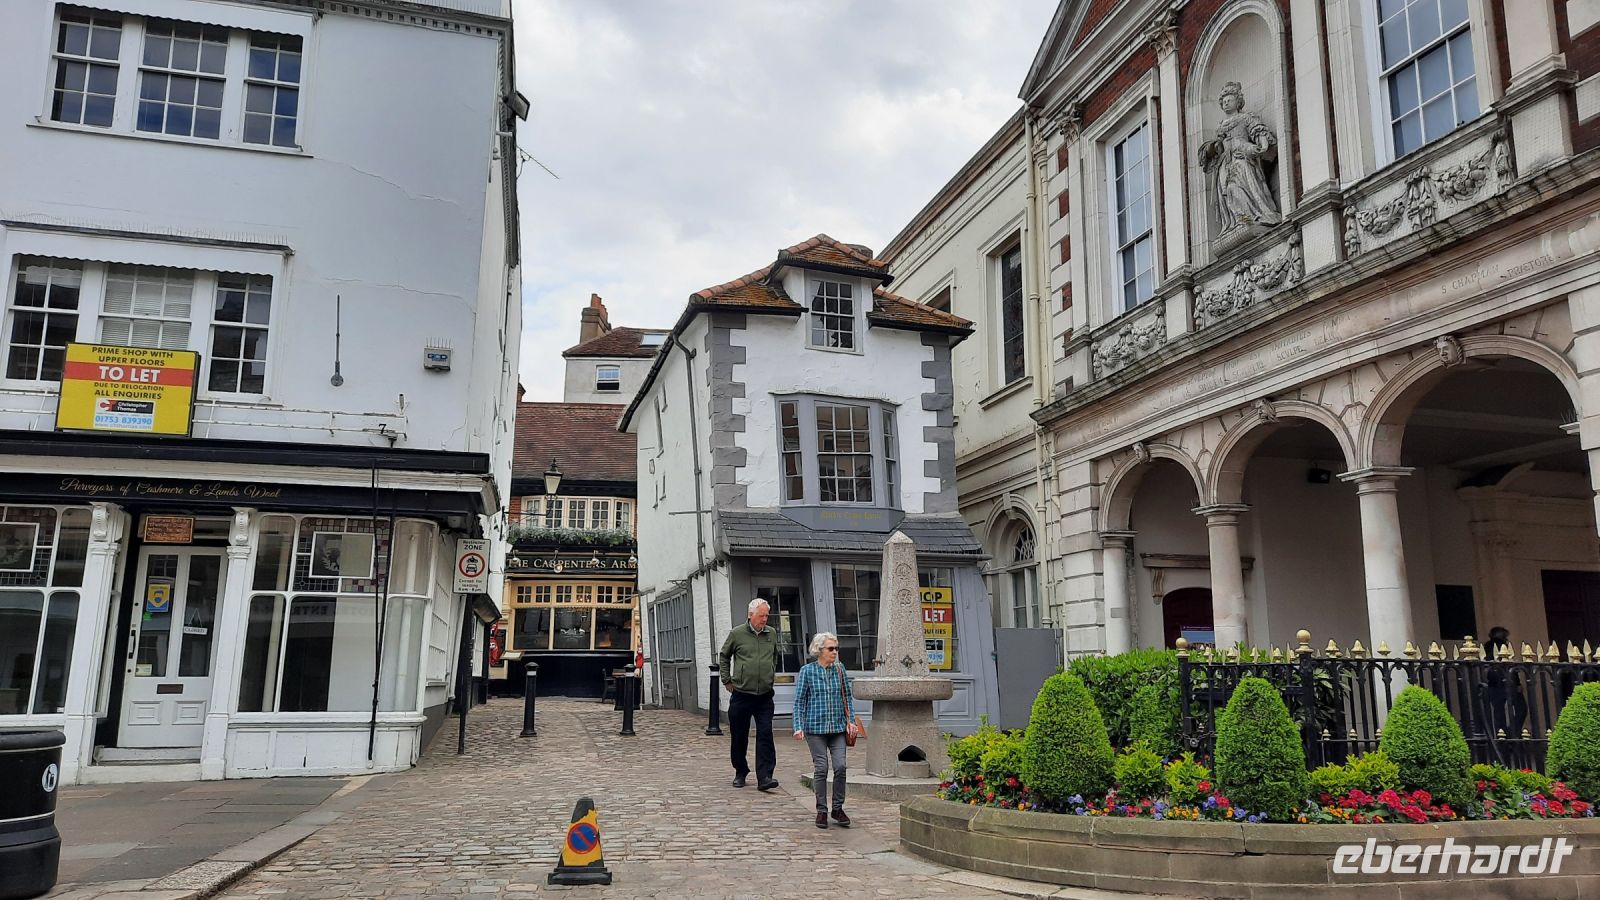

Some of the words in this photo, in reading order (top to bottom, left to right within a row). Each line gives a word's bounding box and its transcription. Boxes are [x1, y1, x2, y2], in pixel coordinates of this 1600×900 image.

[92, 346, 120, 355] PRIME
[122, 348, 148, 357] SHOP
[150, 350, 173, 358] WITH
[98, 356, 127, 364] UPPER
[130, 358, 165, 366] FLOORS
[99, 365, 124, 381] TO
[131, 368, 161, 383] LET
[113, 391, 162, 399] ENQUIRIES
[95, 415, 119, 424] 01753
[121, 417, 153, 425] 839390
[59, 477, 113, 496] Purveyors
[120, 482, 132, 496] of
[136, 482, 184, 495] Cashmere
[243, 484, 282, 498] Wool
[533, 558, 606, 569] CARPENTERS
[924, 609, 945, 622] LET
